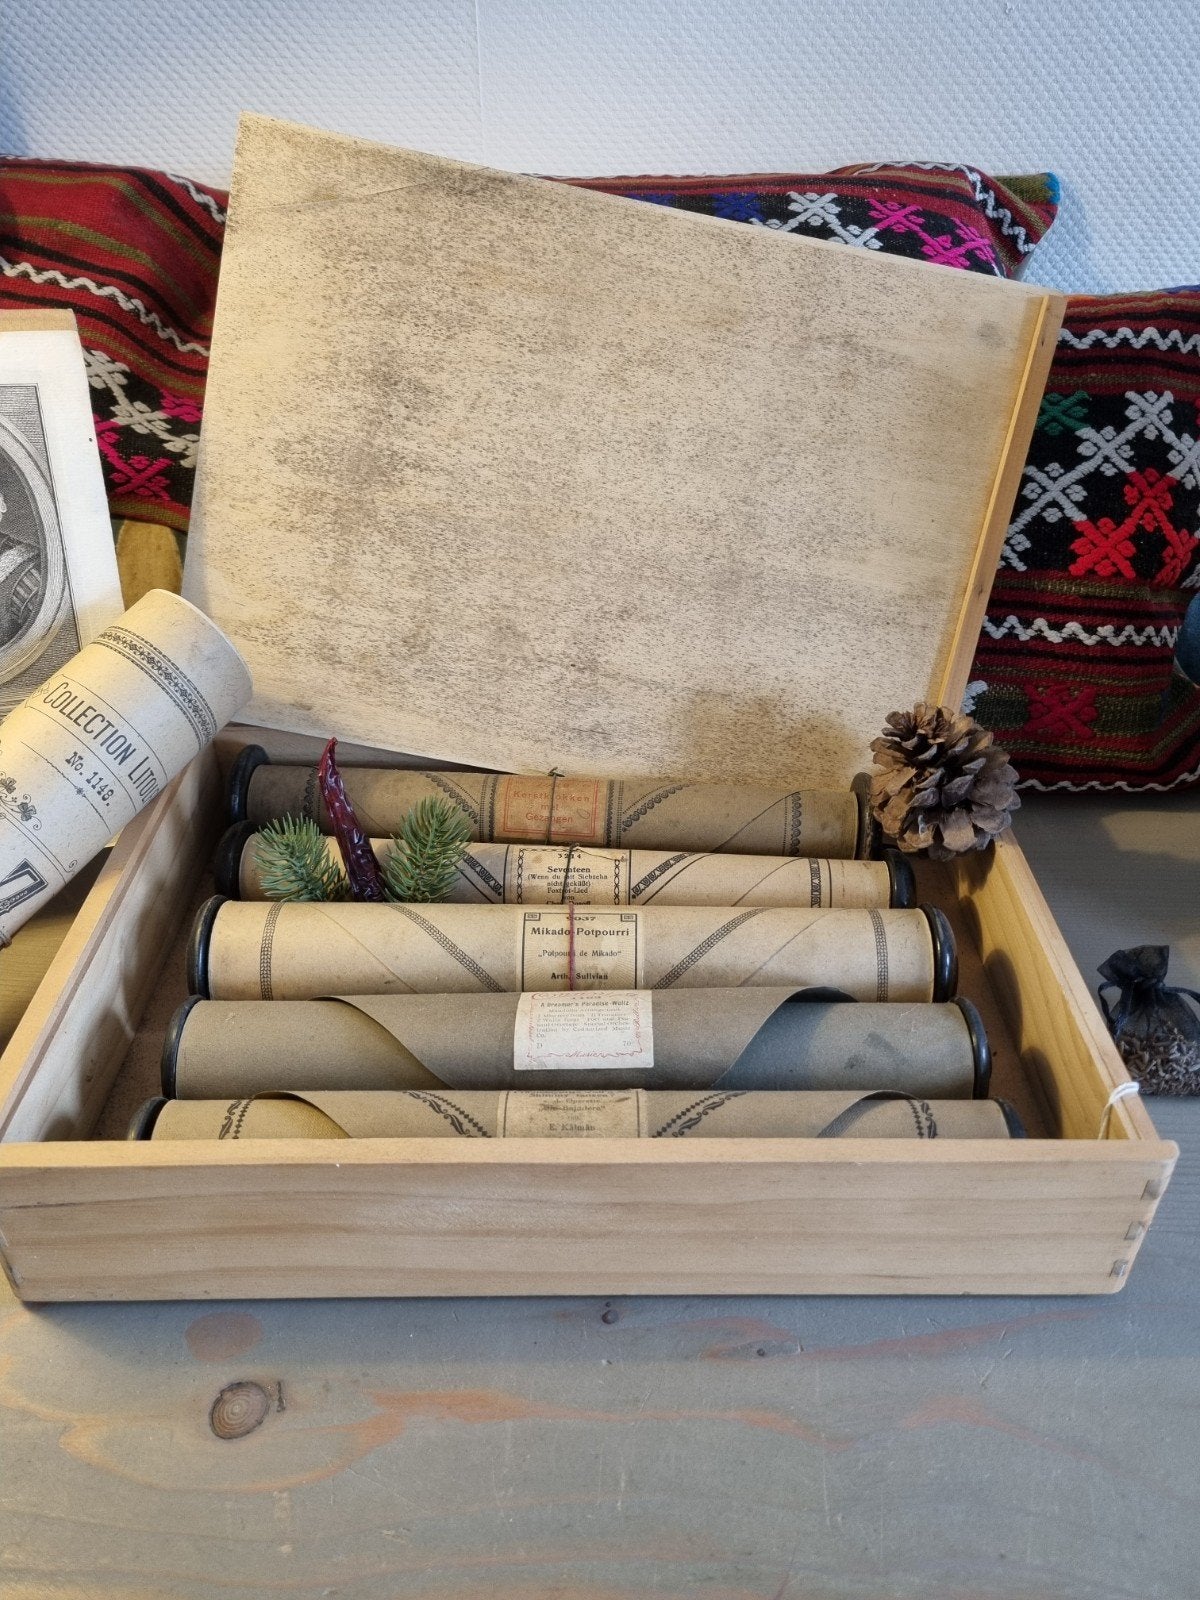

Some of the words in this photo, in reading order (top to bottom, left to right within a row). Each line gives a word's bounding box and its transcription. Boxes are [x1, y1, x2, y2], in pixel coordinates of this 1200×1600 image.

[43, 682, 137, 766] COLLECTION
[65, 751, 83, 776] No.
[86, 771, 115, 807] 1148.
[513, 790, 591, 802] Kerstkokken
[540, 803, 560, 811] mt
[580, 949, 588, 957] de
